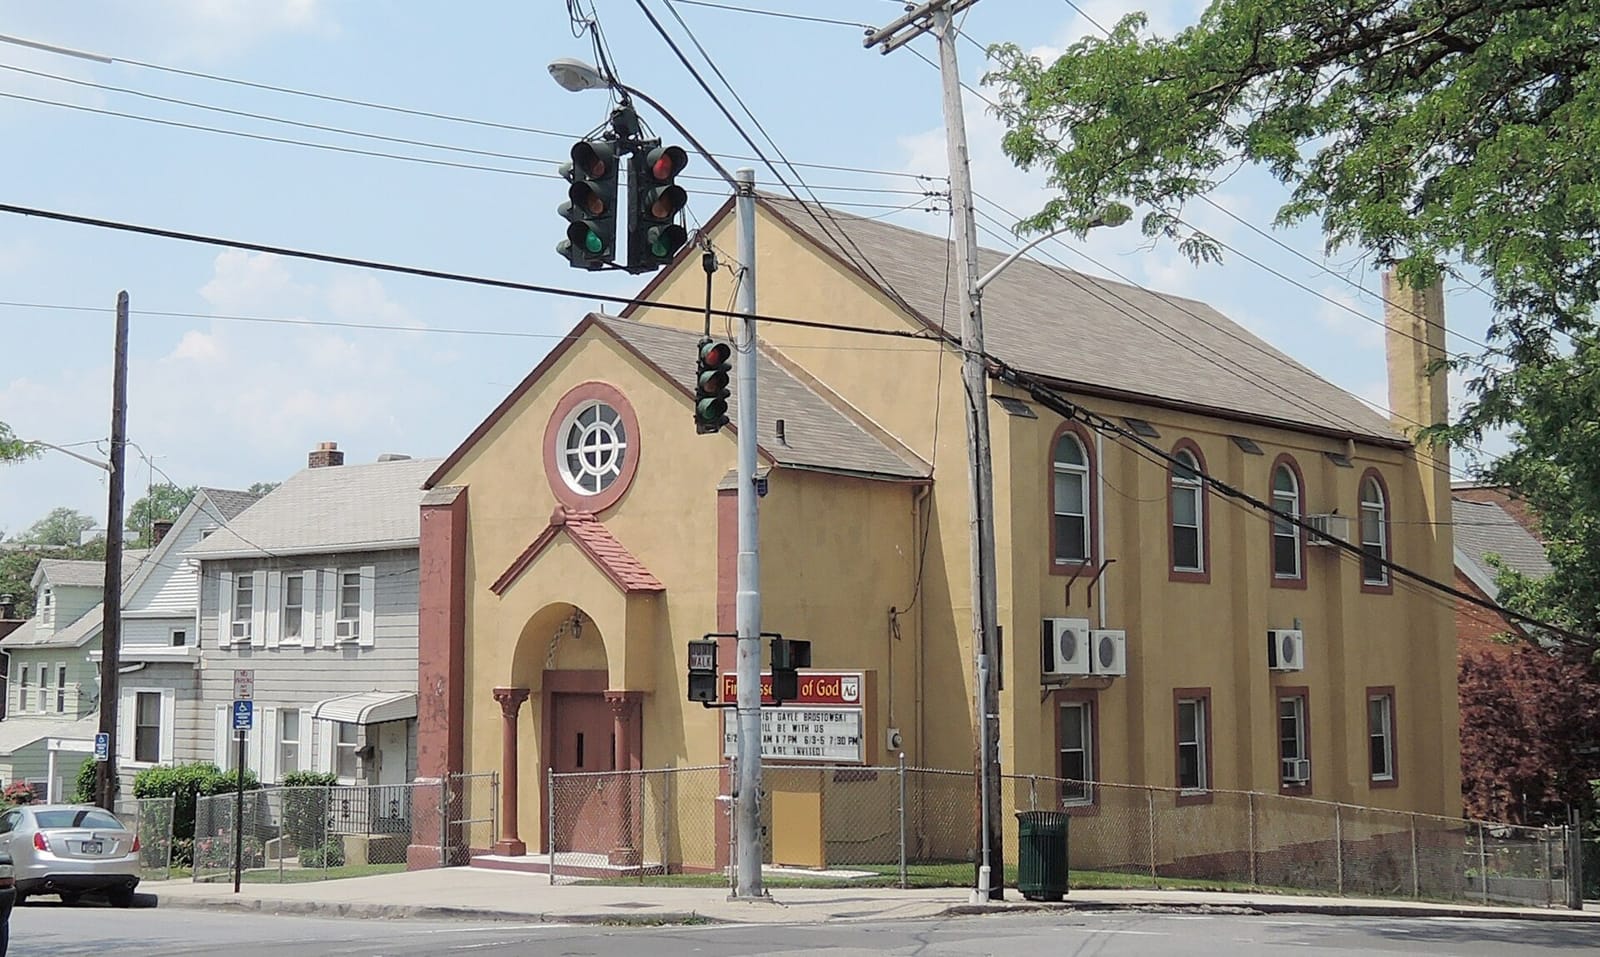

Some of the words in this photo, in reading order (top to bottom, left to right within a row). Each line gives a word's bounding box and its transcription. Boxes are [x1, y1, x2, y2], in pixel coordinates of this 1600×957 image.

[690, 656, 712, 667] WALK
[802, 679, 814, 696] of
[816, 679, 839, 696] God
[843, 685, 856, 697] AG
[777, 712, 798, 721] GAYLE
[761, 723, 771, 732] ILL
[777, 724, 786, 733] BE
[792, 724, 810, 733] WITH
[814, 724, 824, 733] US
[763, 735, 772, 743] AM
[829, 736, 846, 745] 7:30
[848, 736, 858, 745] PM
[773, 746, 786, 755] ARE
